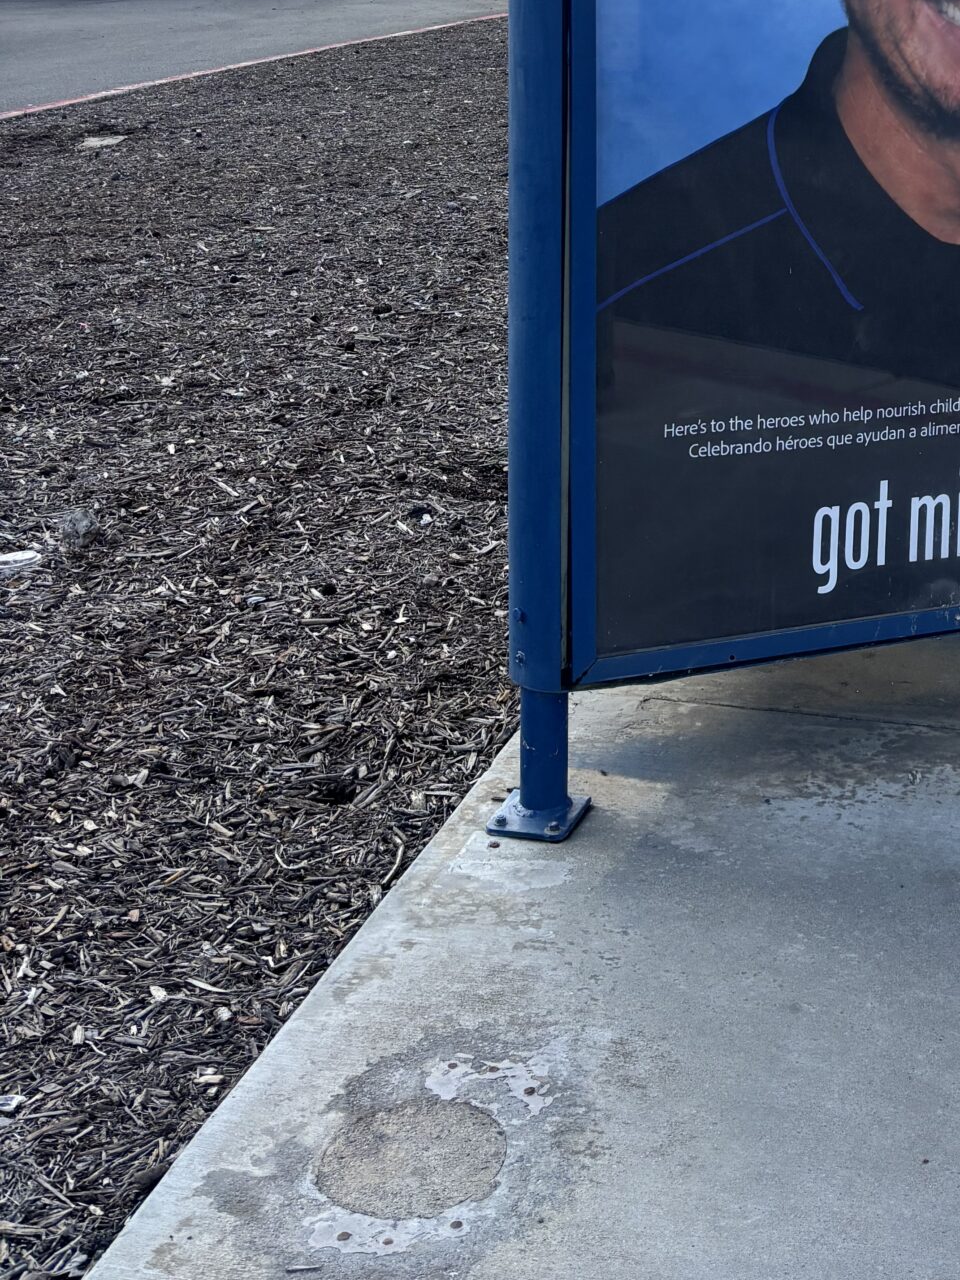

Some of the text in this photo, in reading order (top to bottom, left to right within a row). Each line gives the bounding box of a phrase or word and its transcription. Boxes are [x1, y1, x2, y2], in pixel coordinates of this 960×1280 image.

[663, 418, 707, 439] Here's
[709, 418, 726, 433] to
[728, 415, 754, 432] the
[756, 413, 806, 430] heroes
[808, 408, 840, 426] who
[843, 405, 873, 425] help
[876, 400, 926, 420] nourish
[688, 437, 773, 458] Celebrando
[775, 434, 824, 452] héroes
[826, 433, 853, 451] que
[855, 425, 906, 447] ayudan
[908, 427, 917, 439] a
[812, 480, 893, 595] got
